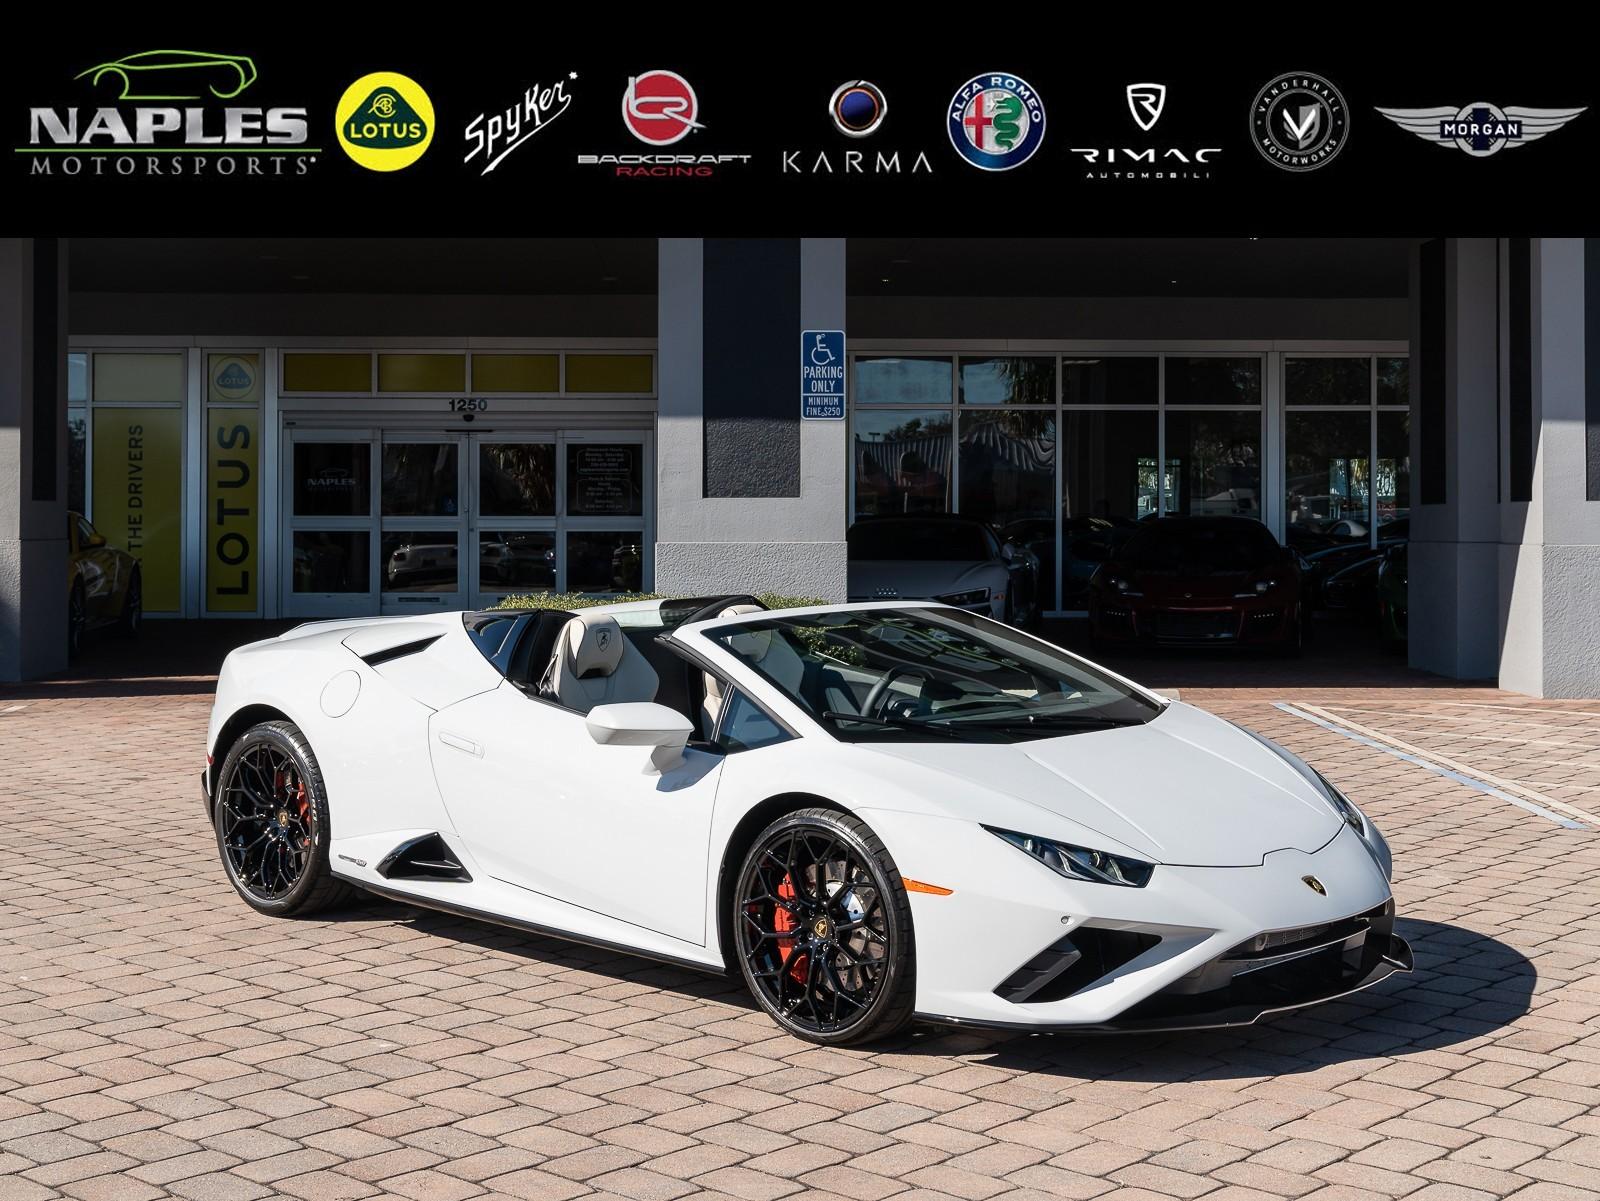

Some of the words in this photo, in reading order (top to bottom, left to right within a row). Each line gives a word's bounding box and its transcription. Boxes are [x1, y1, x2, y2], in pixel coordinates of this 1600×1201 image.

[803, 366, 843, 379] PARKING
[218, 377, 250, 385] LOTUS
[811, 380, 836, 393] ONLY
[449, 398, 488, 411] 1250
[808, 397, 839, 406] MINIMUM
[806, 407, 821, 416] FINE
[824, 407, 841, 416] $250
[128, 424, 144, 508] DRIVERS
[216, 424, 250, 595] LOTUS
[128, 514, 143, 552] THE
